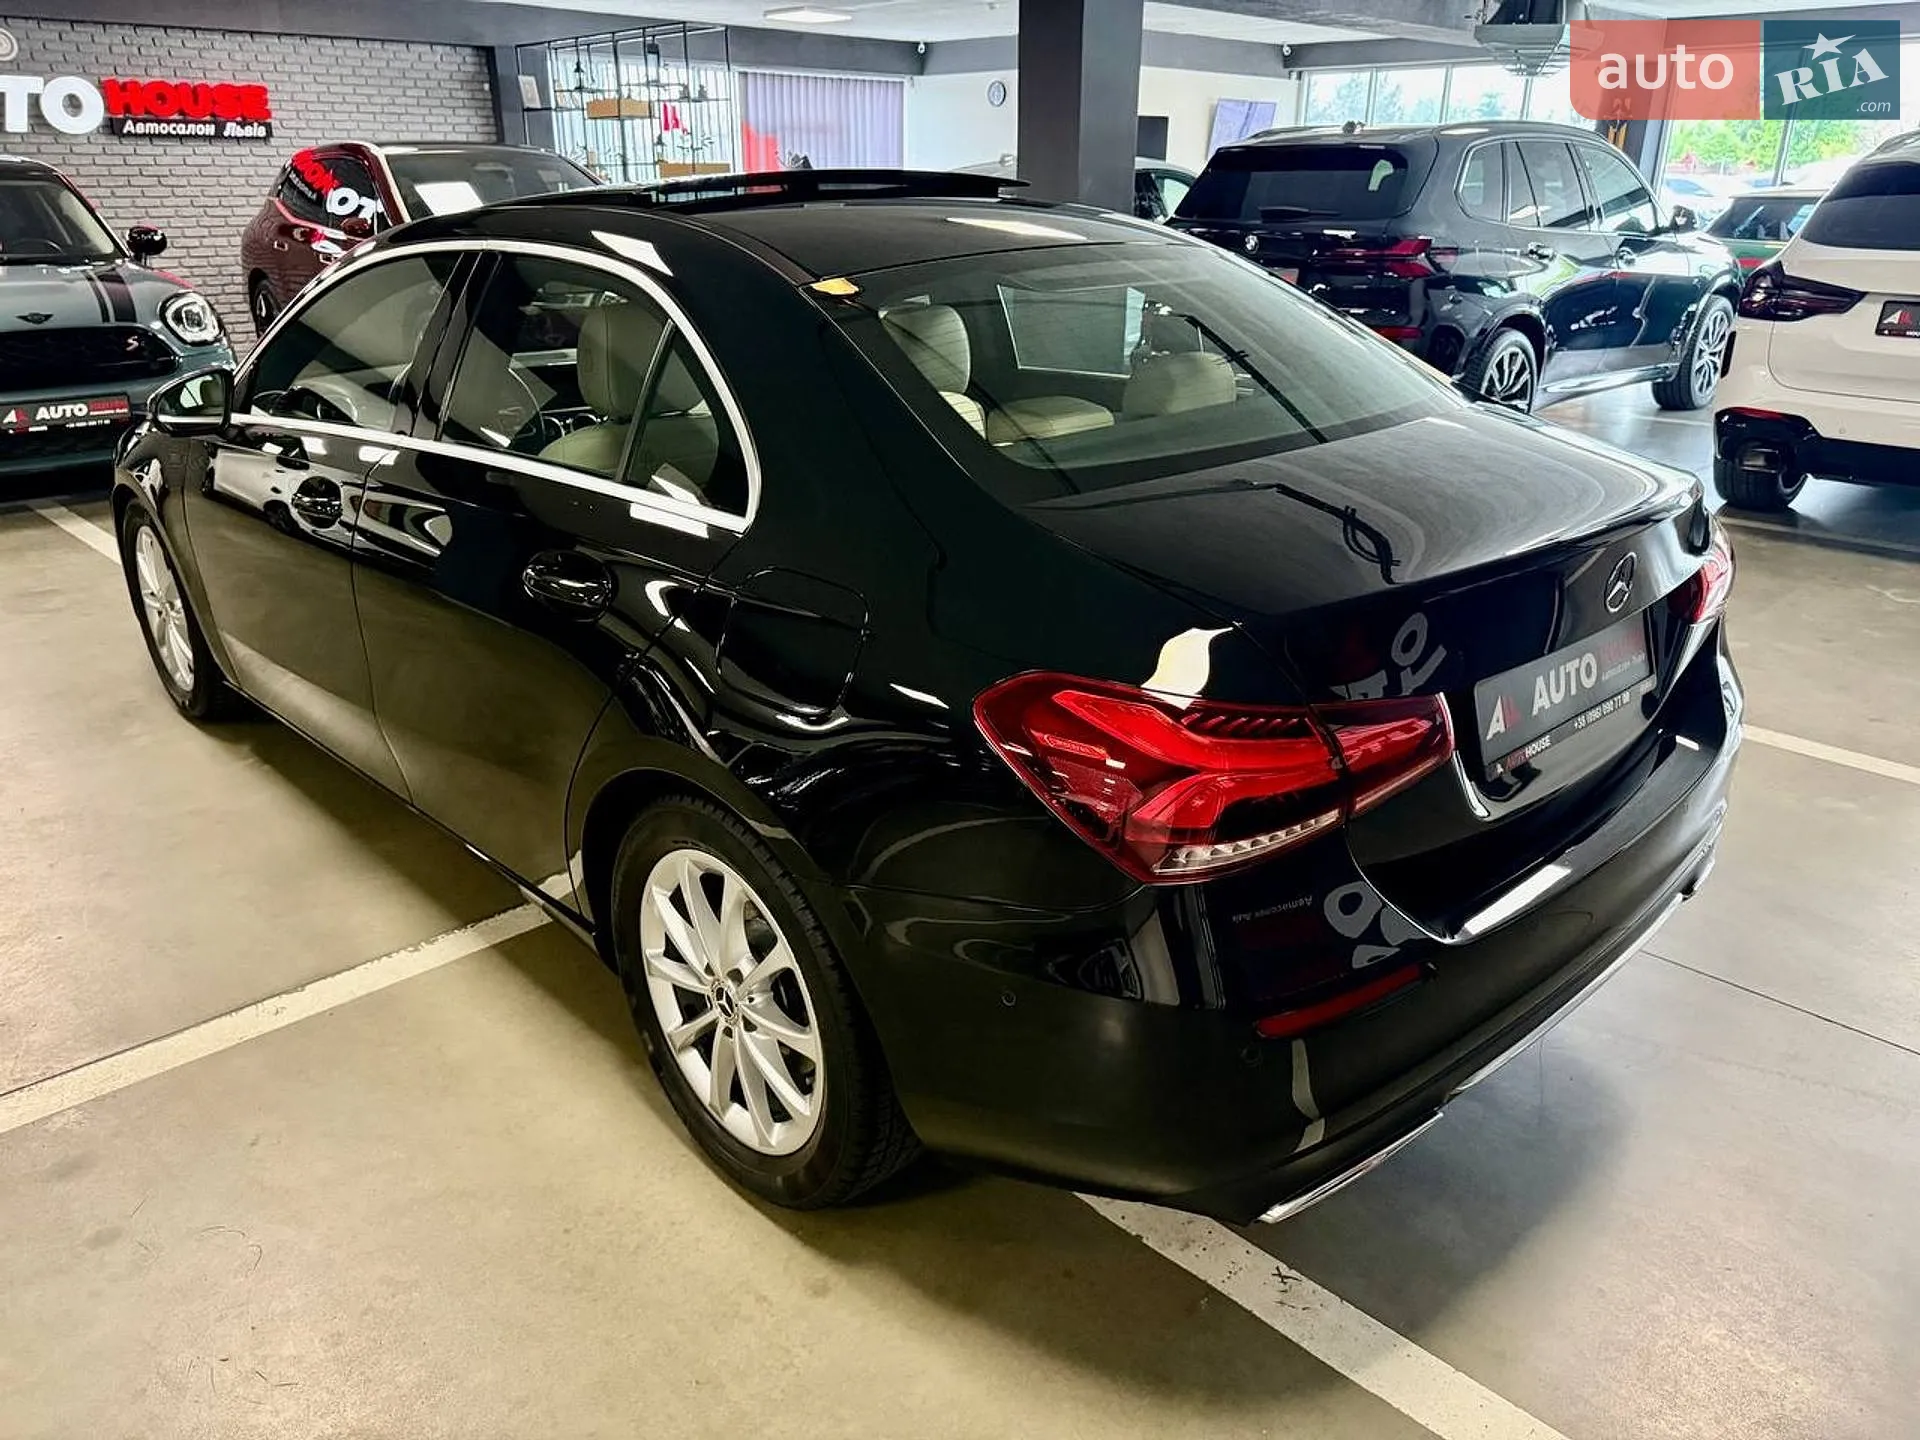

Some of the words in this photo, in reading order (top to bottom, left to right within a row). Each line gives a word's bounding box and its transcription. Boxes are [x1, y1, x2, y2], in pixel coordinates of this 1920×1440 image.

[102, 77, 272, 119] HOUSE
[123, 119, 215, 136] Автосалон
[224, 121, 267, 137] Львів
[35, 404, 88, 420] AUTO
[1532, 652, 1598, 716] AUTO
